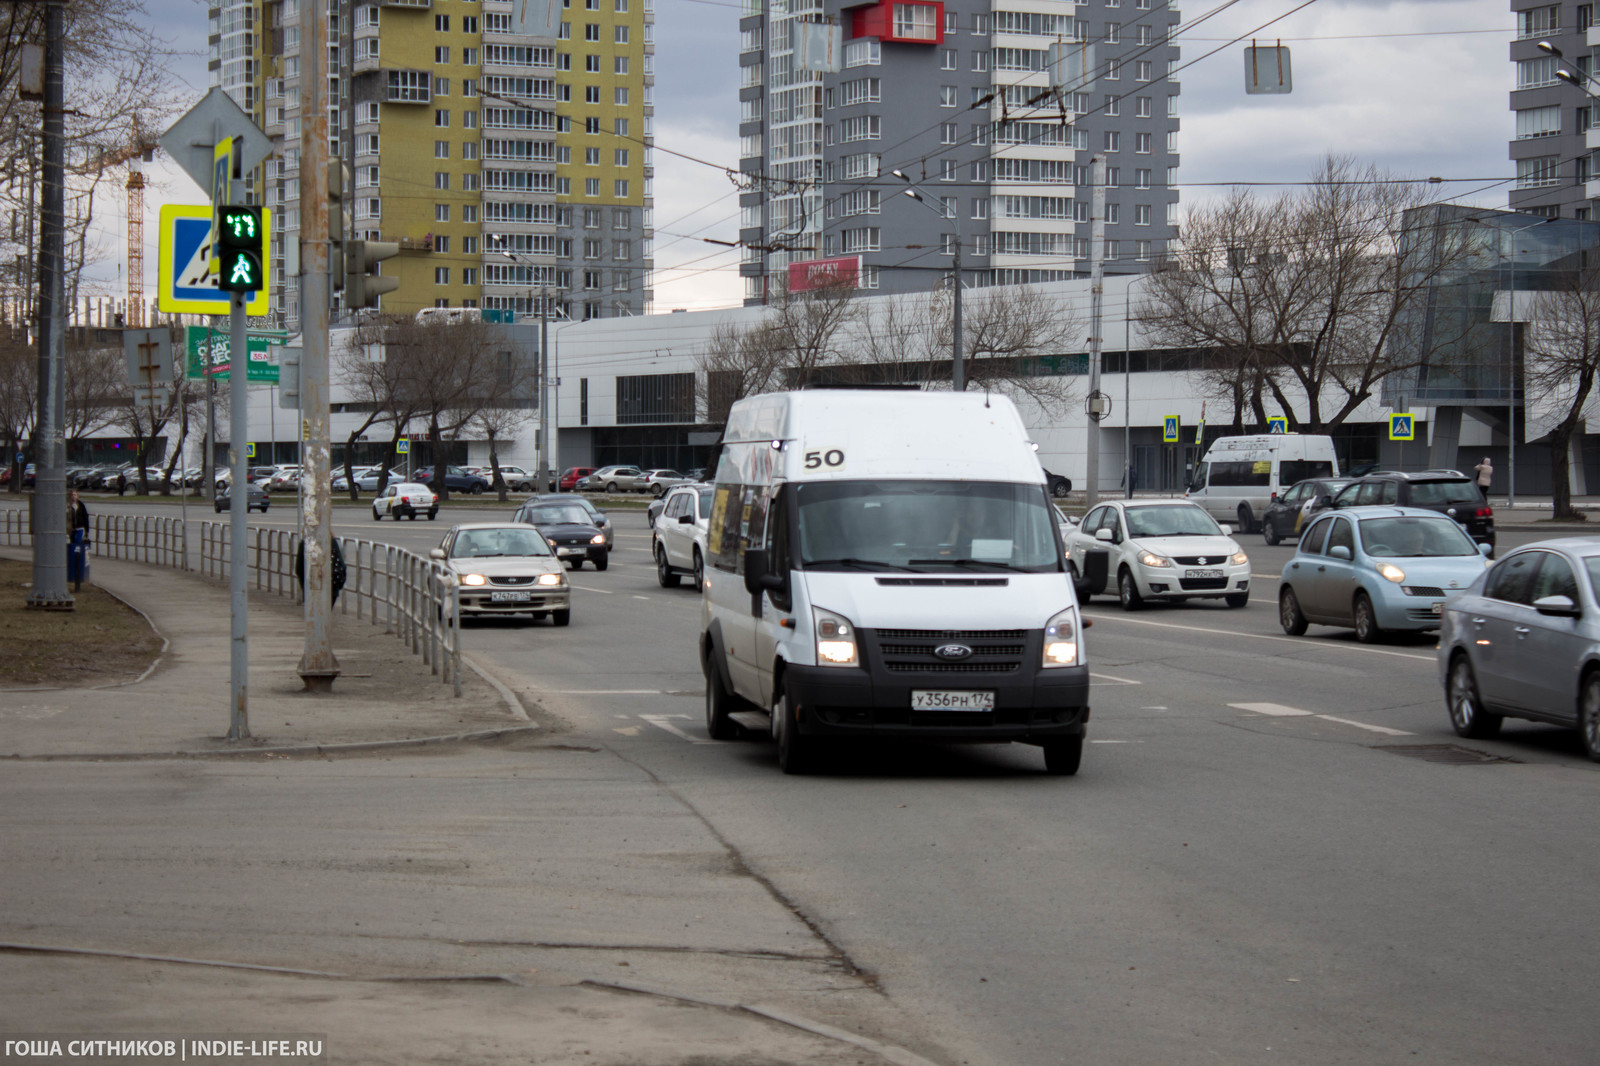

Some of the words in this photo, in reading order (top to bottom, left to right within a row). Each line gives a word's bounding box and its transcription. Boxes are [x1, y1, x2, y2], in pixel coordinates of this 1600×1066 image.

[804, 449, 845, 469] 50
[943, 647, 964, 656] Ford
[916, 692, 969, 707] У356РН
[971, 693, 992, 704] 174
